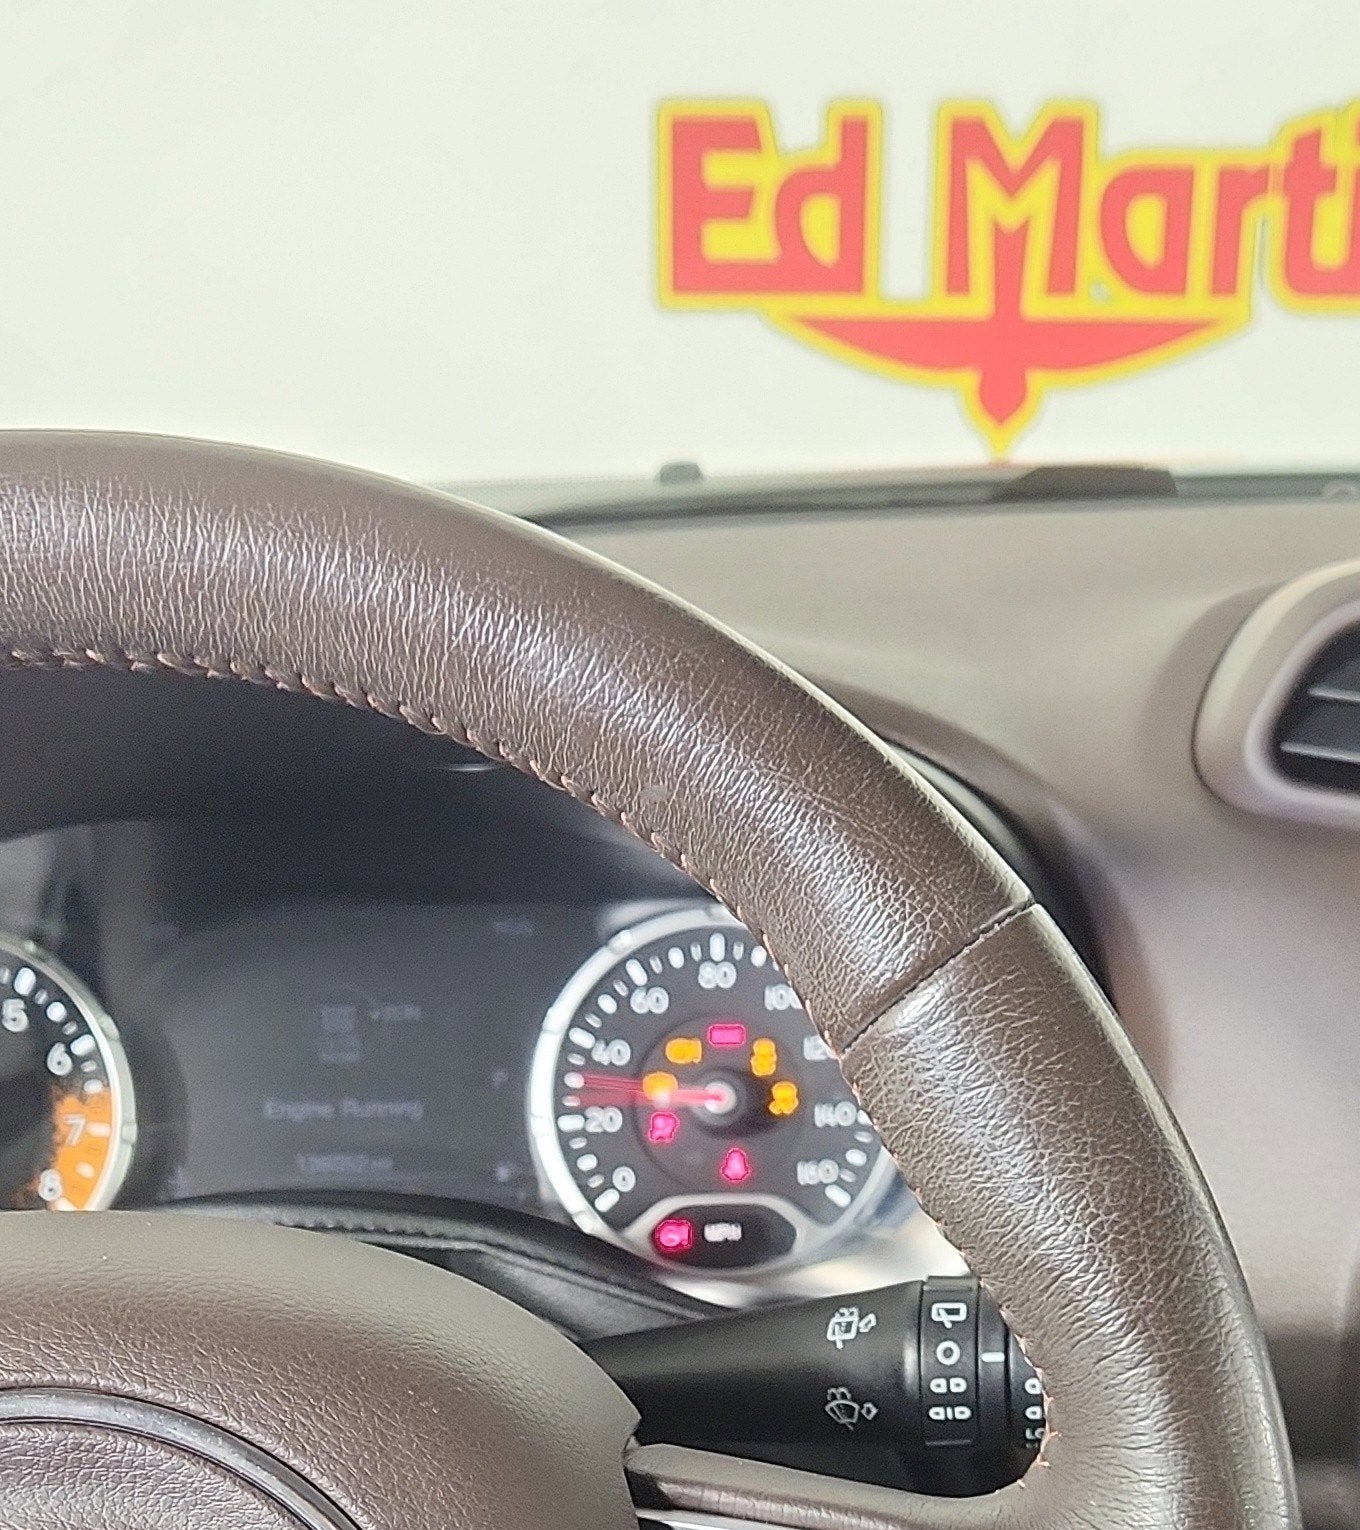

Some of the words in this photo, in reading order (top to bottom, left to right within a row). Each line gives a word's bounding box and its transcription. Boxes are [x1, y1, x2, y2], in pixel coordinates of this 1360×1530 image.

[1, 998, 28, 1032] 5
[47, 1042, 72, 1076] 6
[63, 1114, 86, 1146] 7
[584, 1106, 623, 1132] 20
[39, 1168, 62, 1202] 8
[612, 1166, 636, 1193] 0
